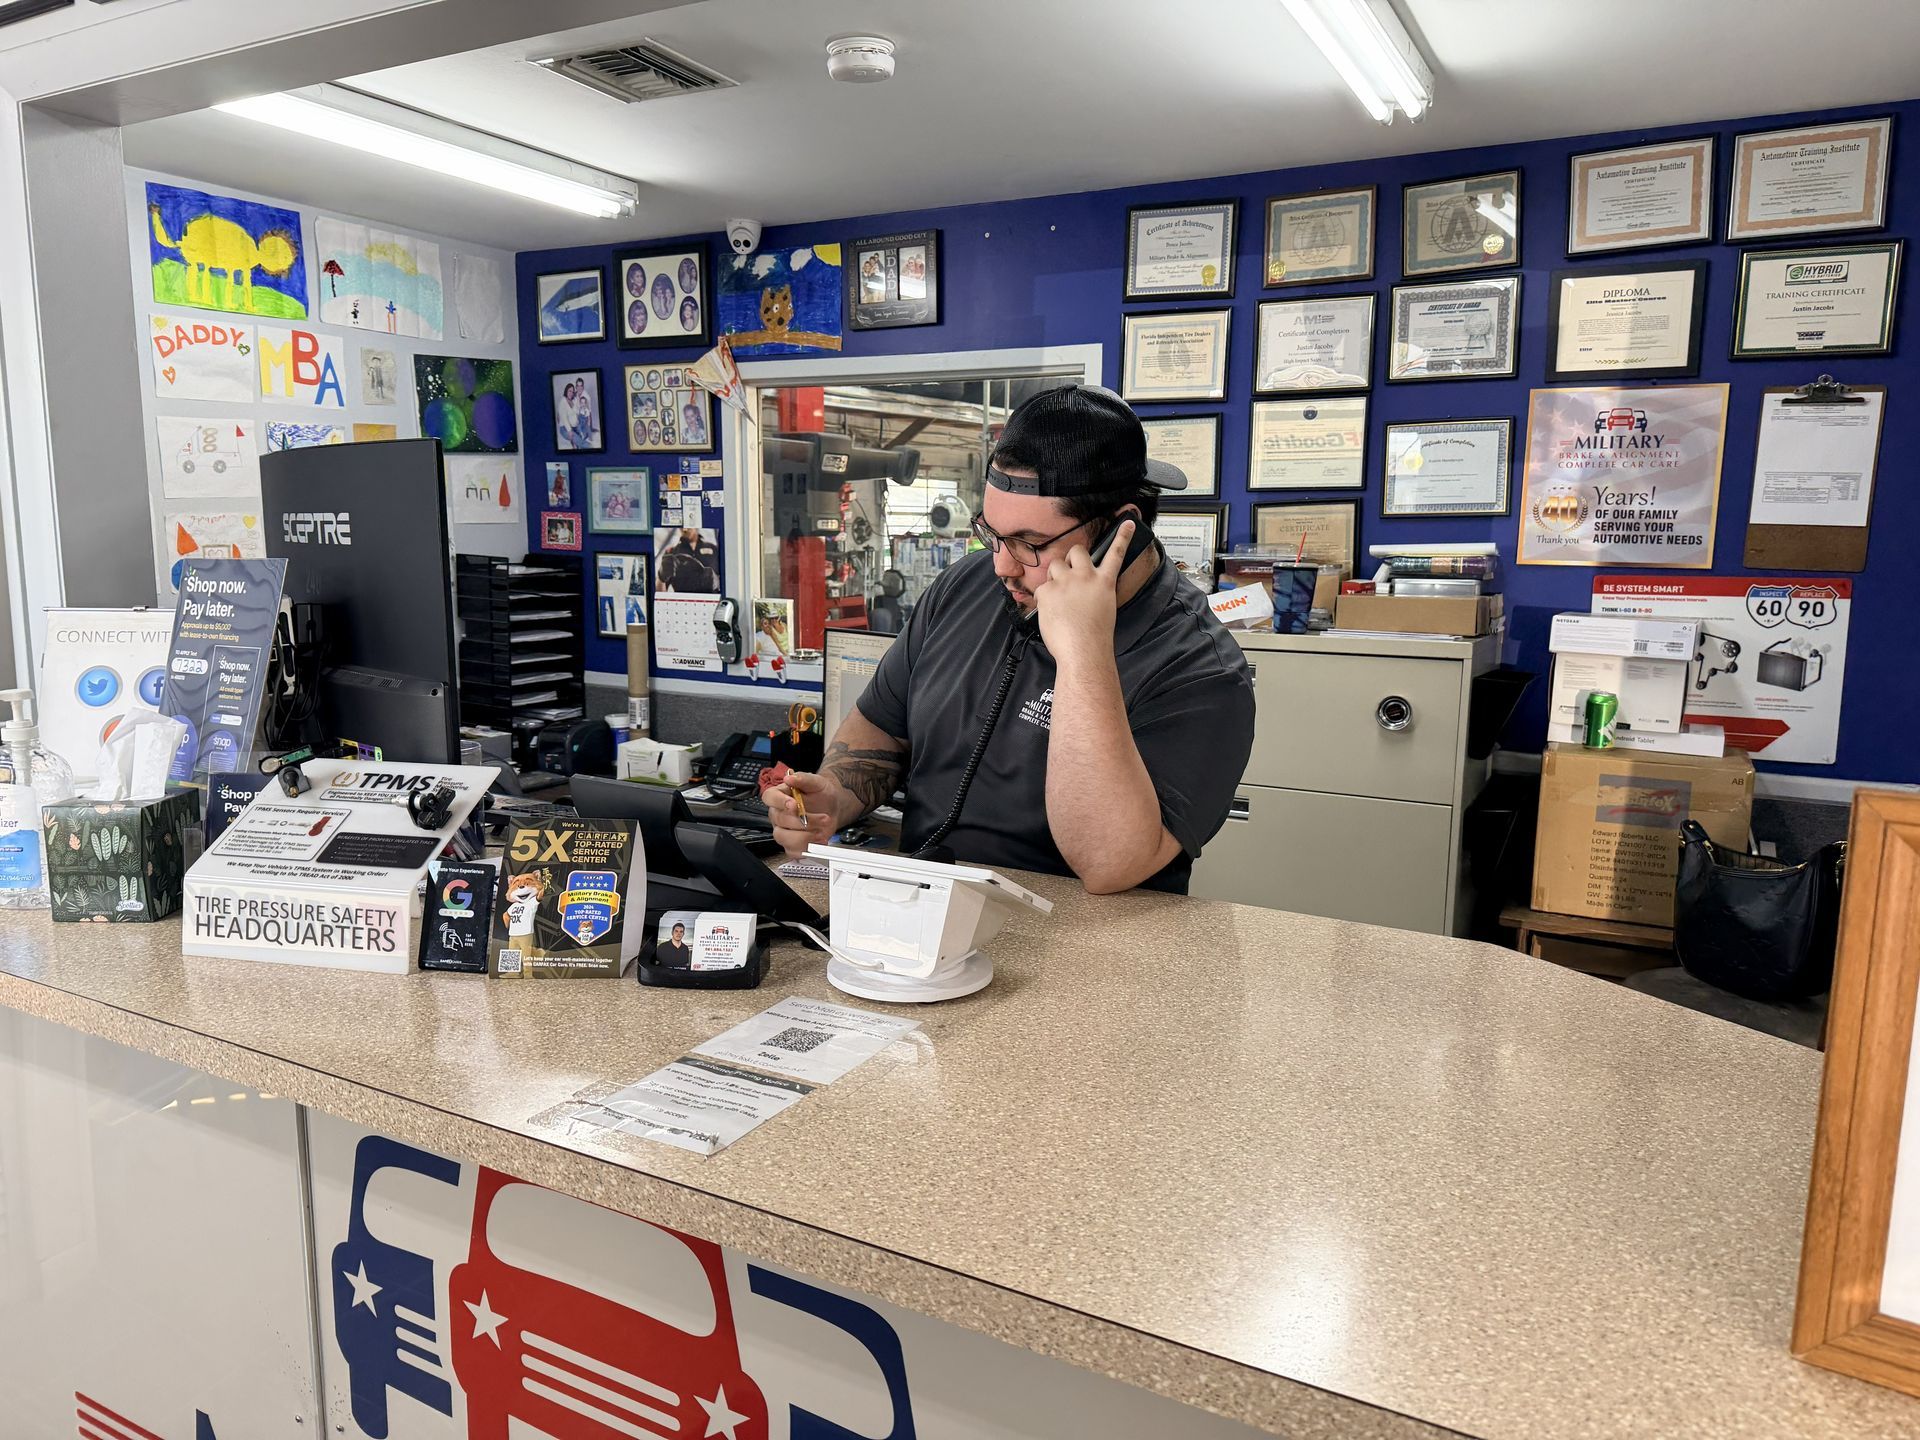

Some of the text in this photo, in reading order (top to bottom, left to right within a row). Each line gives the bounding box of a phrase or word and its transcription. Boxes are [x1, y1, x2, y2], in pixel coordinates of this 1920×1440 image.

[1799, 147, 1828, 157] Training
[1829, 143, 1860, 154] Institute
[1804, 264, 1844, 275] HYBRID
[1603, 287, 1651, 299] DIPLOMA
[1766, 287, 1866, 300] TRAINING CERTIFICATE
[153, 324, 245, 358] DADDY
[259, 330, 345, 407] MBA
[1574, 433, 1665, 450] MILITARY
[1559, 451, 1594, 459] BRAKE
[1612, 450, 1680, 459] ALIGNMENT
[1558, 460, 1680, 469] COMPLETE CAR CARE
[1592, 485, 1657, 506] Years!
[1542, 496, 1579, 524] 40
[1595, 509, 1679, 520] OF OUR FAMILY
[283, 512, 351, 545] SCEPTRE
[1594, 521, 1674, 532] SERVING YOUR
[1536, 534, 1580, 547] Thank you
[1592, 534, 1703, 545] AUTOMOTIVE NEEDS
[187, 575, 247, 596] Shop now.
[1603, 584, 1685, 593] BE SYSTEM SMART
[183, 599, 236, 620] Pay later.
[1756, 600, 1782, 616] 60
[1798, 601, 1825, 617] 90
[56, 630, 171, 643] CONNECT WIT
[219, 659, 251, 672] Shop now.
[679, 658, 706, 666] ADVANCE
[219, 672, 247, 684] Pay later.
[1021, 706, 1035, 717] BRAKE
[1029, 700, 1051, 717] MILIT
[359, 772, 435, 791] TPMS
[1731, 778, 1744, 786] AB
[221, 788, 250, 802] Shop
[224, 802, 246, 816] Pay
[575, 831, 629, 842] CARFAX
[1592, 829, 1617, 837] Edward
[1619, 832, 1644, 840] Roberts
[510, 829, 575, 863] 5X
[574, 840, 623, 849] TOP-RATED
[572, 848, 610, 856] SERVICE
[571, 856, 607, 864] CENTER
[250, 869, 279, 877] According
[311, 867, 333, 875] System
[340, 869, 367, 877] Working
[567, 890, 592, 898] Military
[195, 895, 397, 928] TIRE PRESSURE SAFETY
[511, 905, 525, 915] CAR
[510, 914, 522, 923] FOX
[195, 914, 397, 952] HEADQUARTERS
[695, 1060, 734, 1076] Customer
[733, 1070, 763, 1082] Pricing
[762, 1077, 790, 1087] Notice
